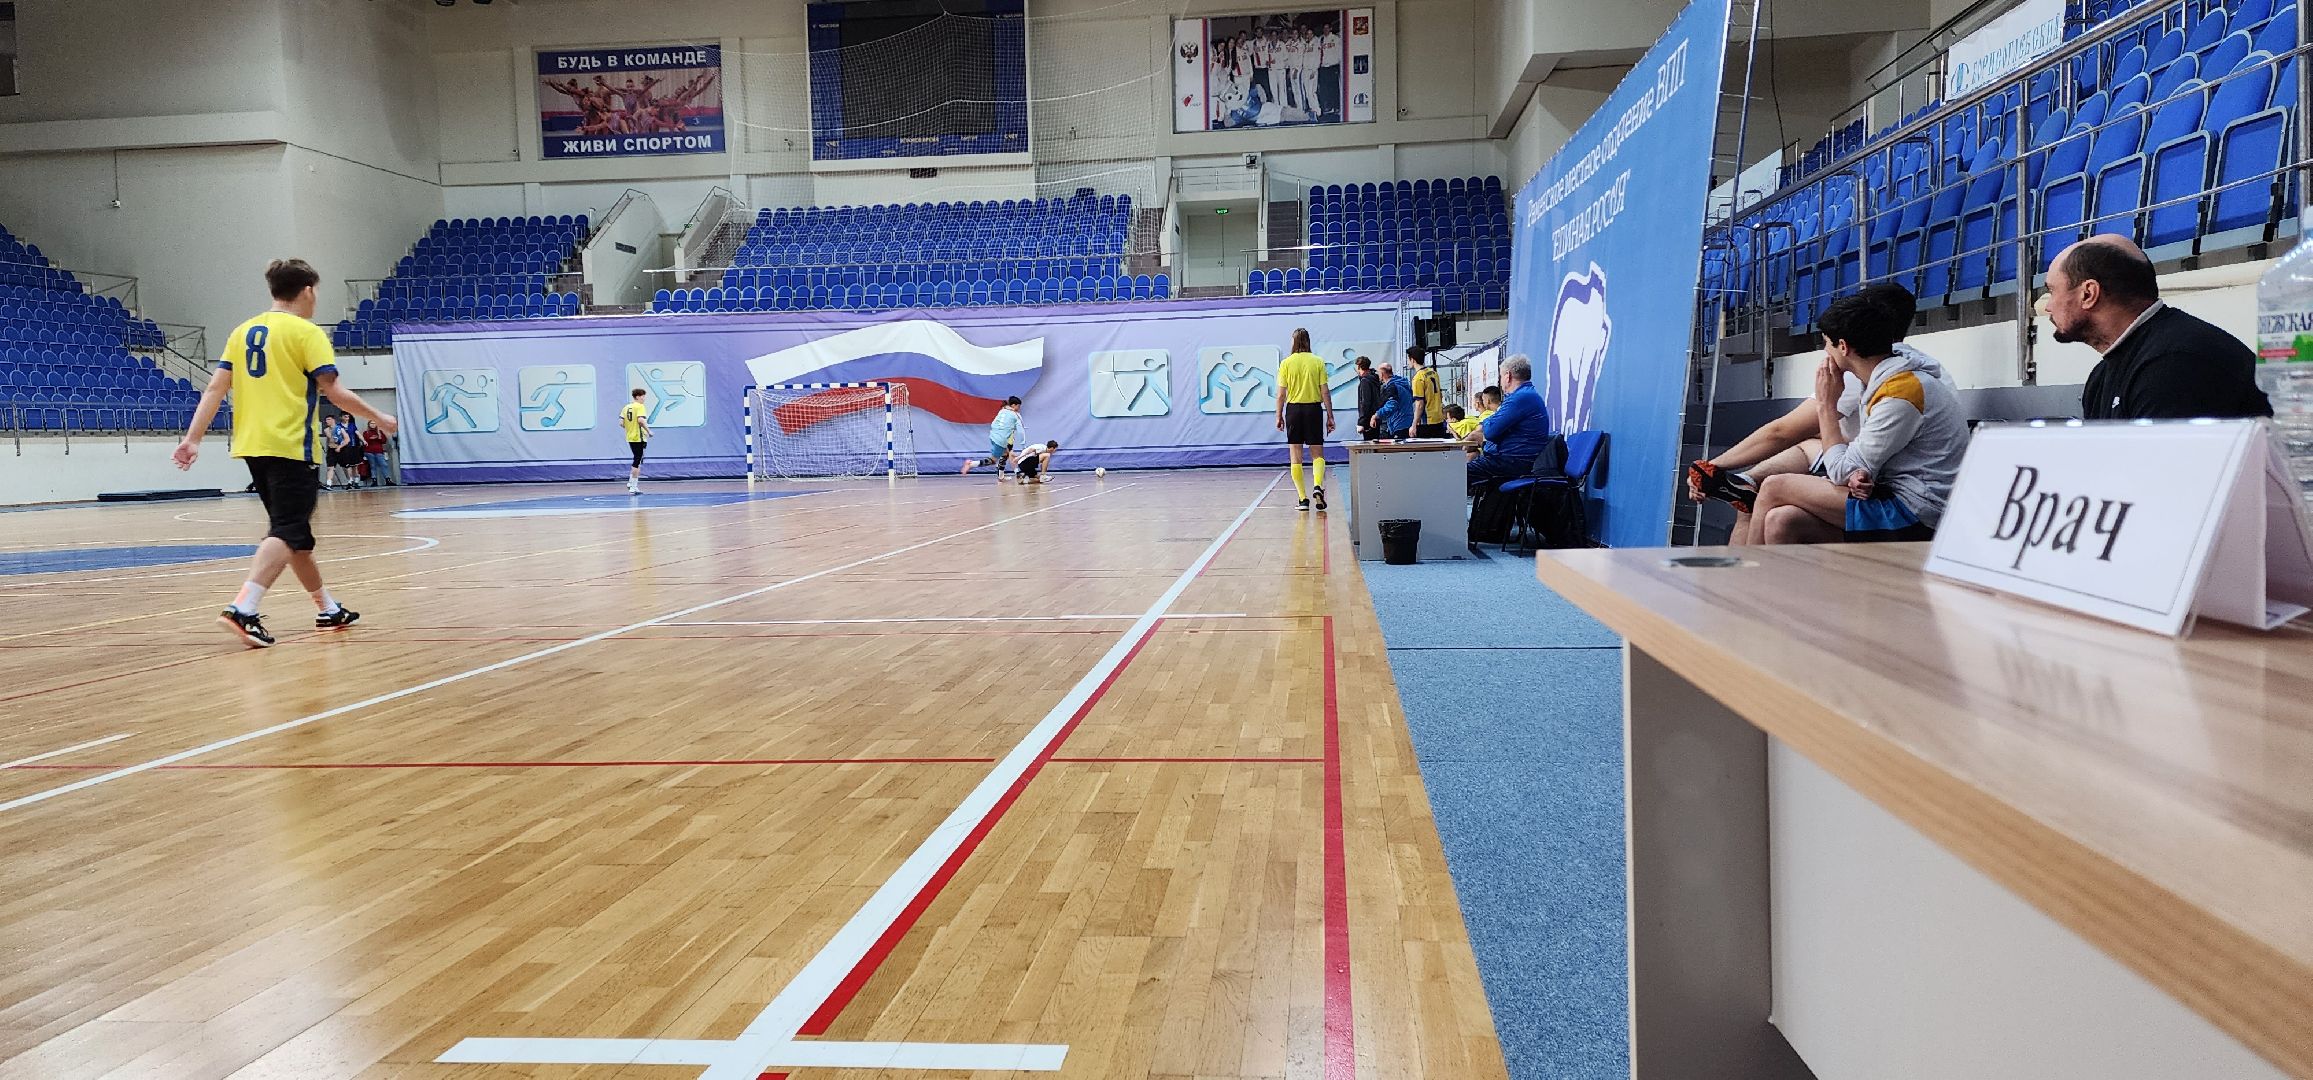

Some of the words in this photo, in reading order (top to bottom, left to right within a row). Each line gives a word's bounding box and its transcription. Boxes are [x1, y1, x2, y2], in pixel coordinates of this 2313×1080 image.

[557, 56, 601, 70] БУДЬ
[607, 55, 618, 67] В
[624, 51, 707, 67] КОМАНДЕ
[1602, 86, 1655, 165] отделение
[1656, 38, 1689, 110] ВПП
[563, 138, 617, 153] ЖИВИ
[623, 134, 712, 151] СПОРТОМ
[245, 325, 270, 379] 8
[1430, 377, 1437, 393] 1
[1990, 465, 2134, 571] Врач
